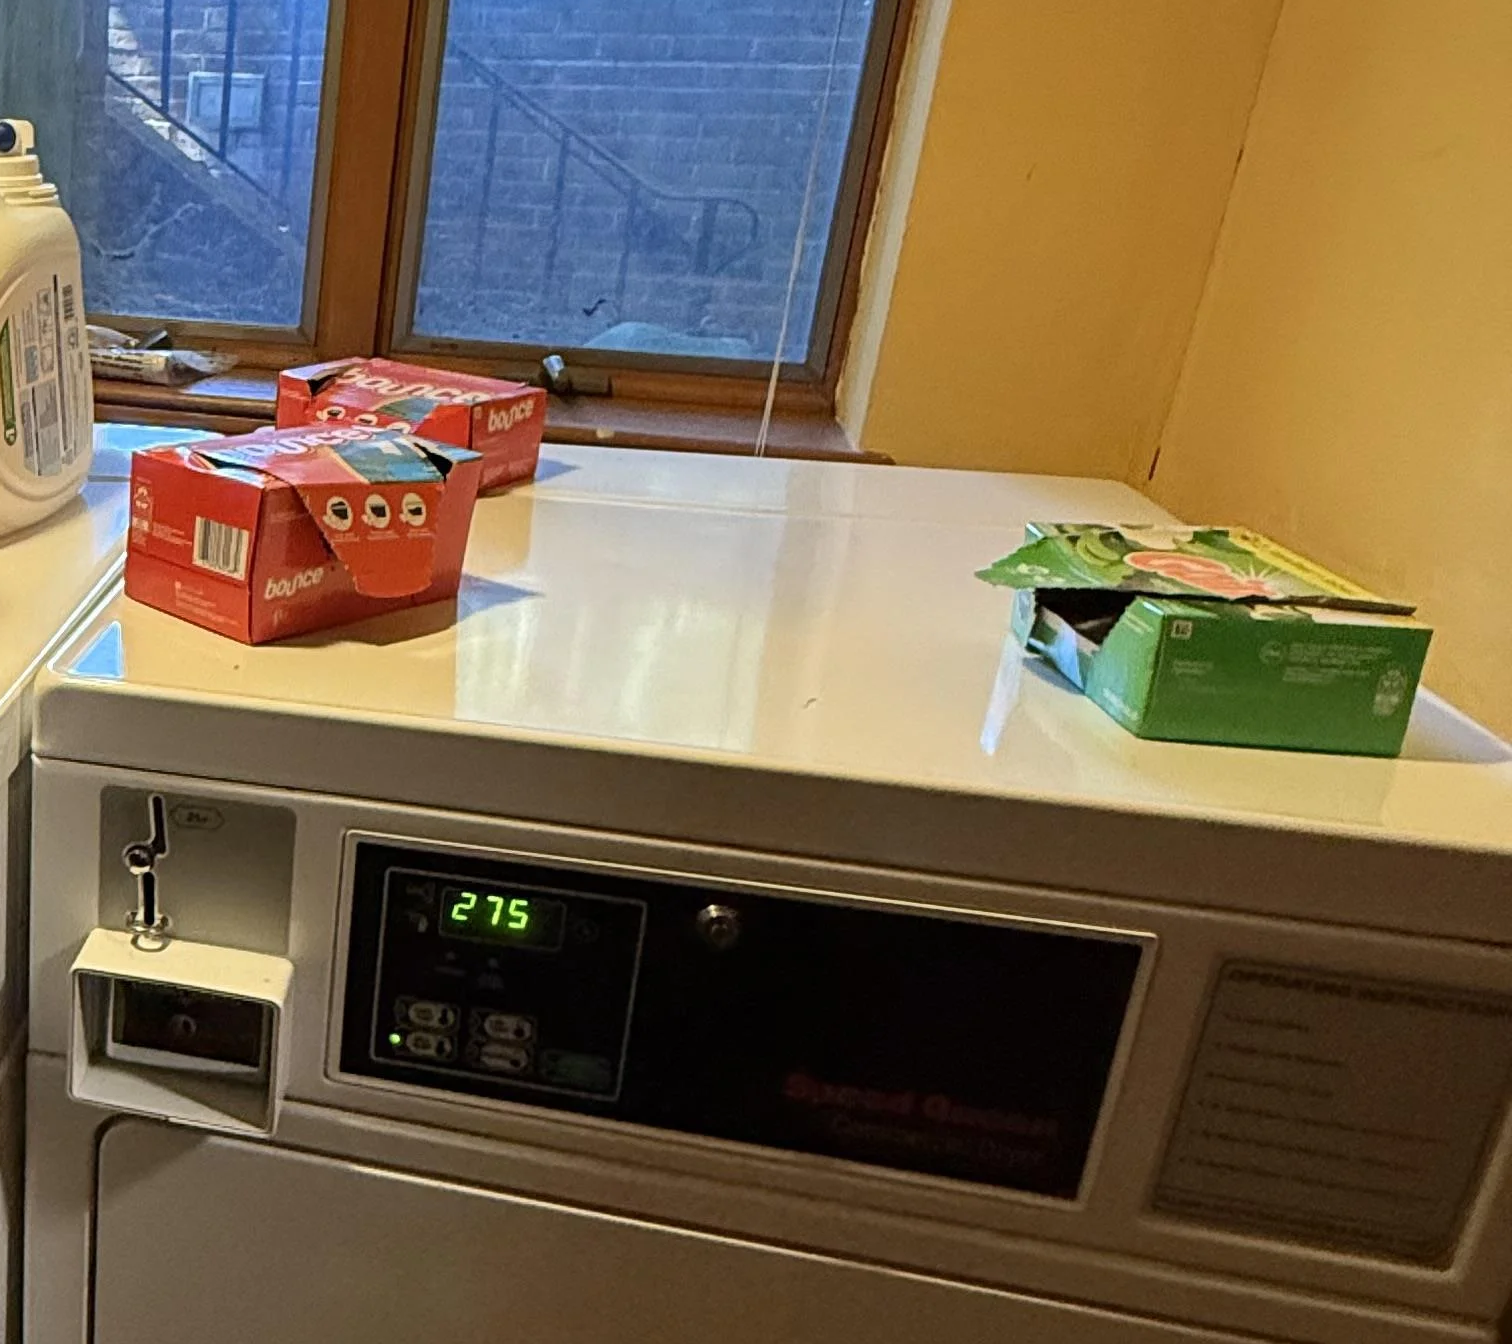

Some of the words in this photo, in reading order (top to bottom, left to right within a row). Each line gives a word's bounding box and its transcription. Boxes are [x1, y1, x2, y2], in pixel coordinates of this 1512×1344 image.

[337, 366, 491, 405] bounce
[488, 398, 536, 433] bounce
[264, 566, 325, 600] bounce
[451, 891, 529, 930] 275
